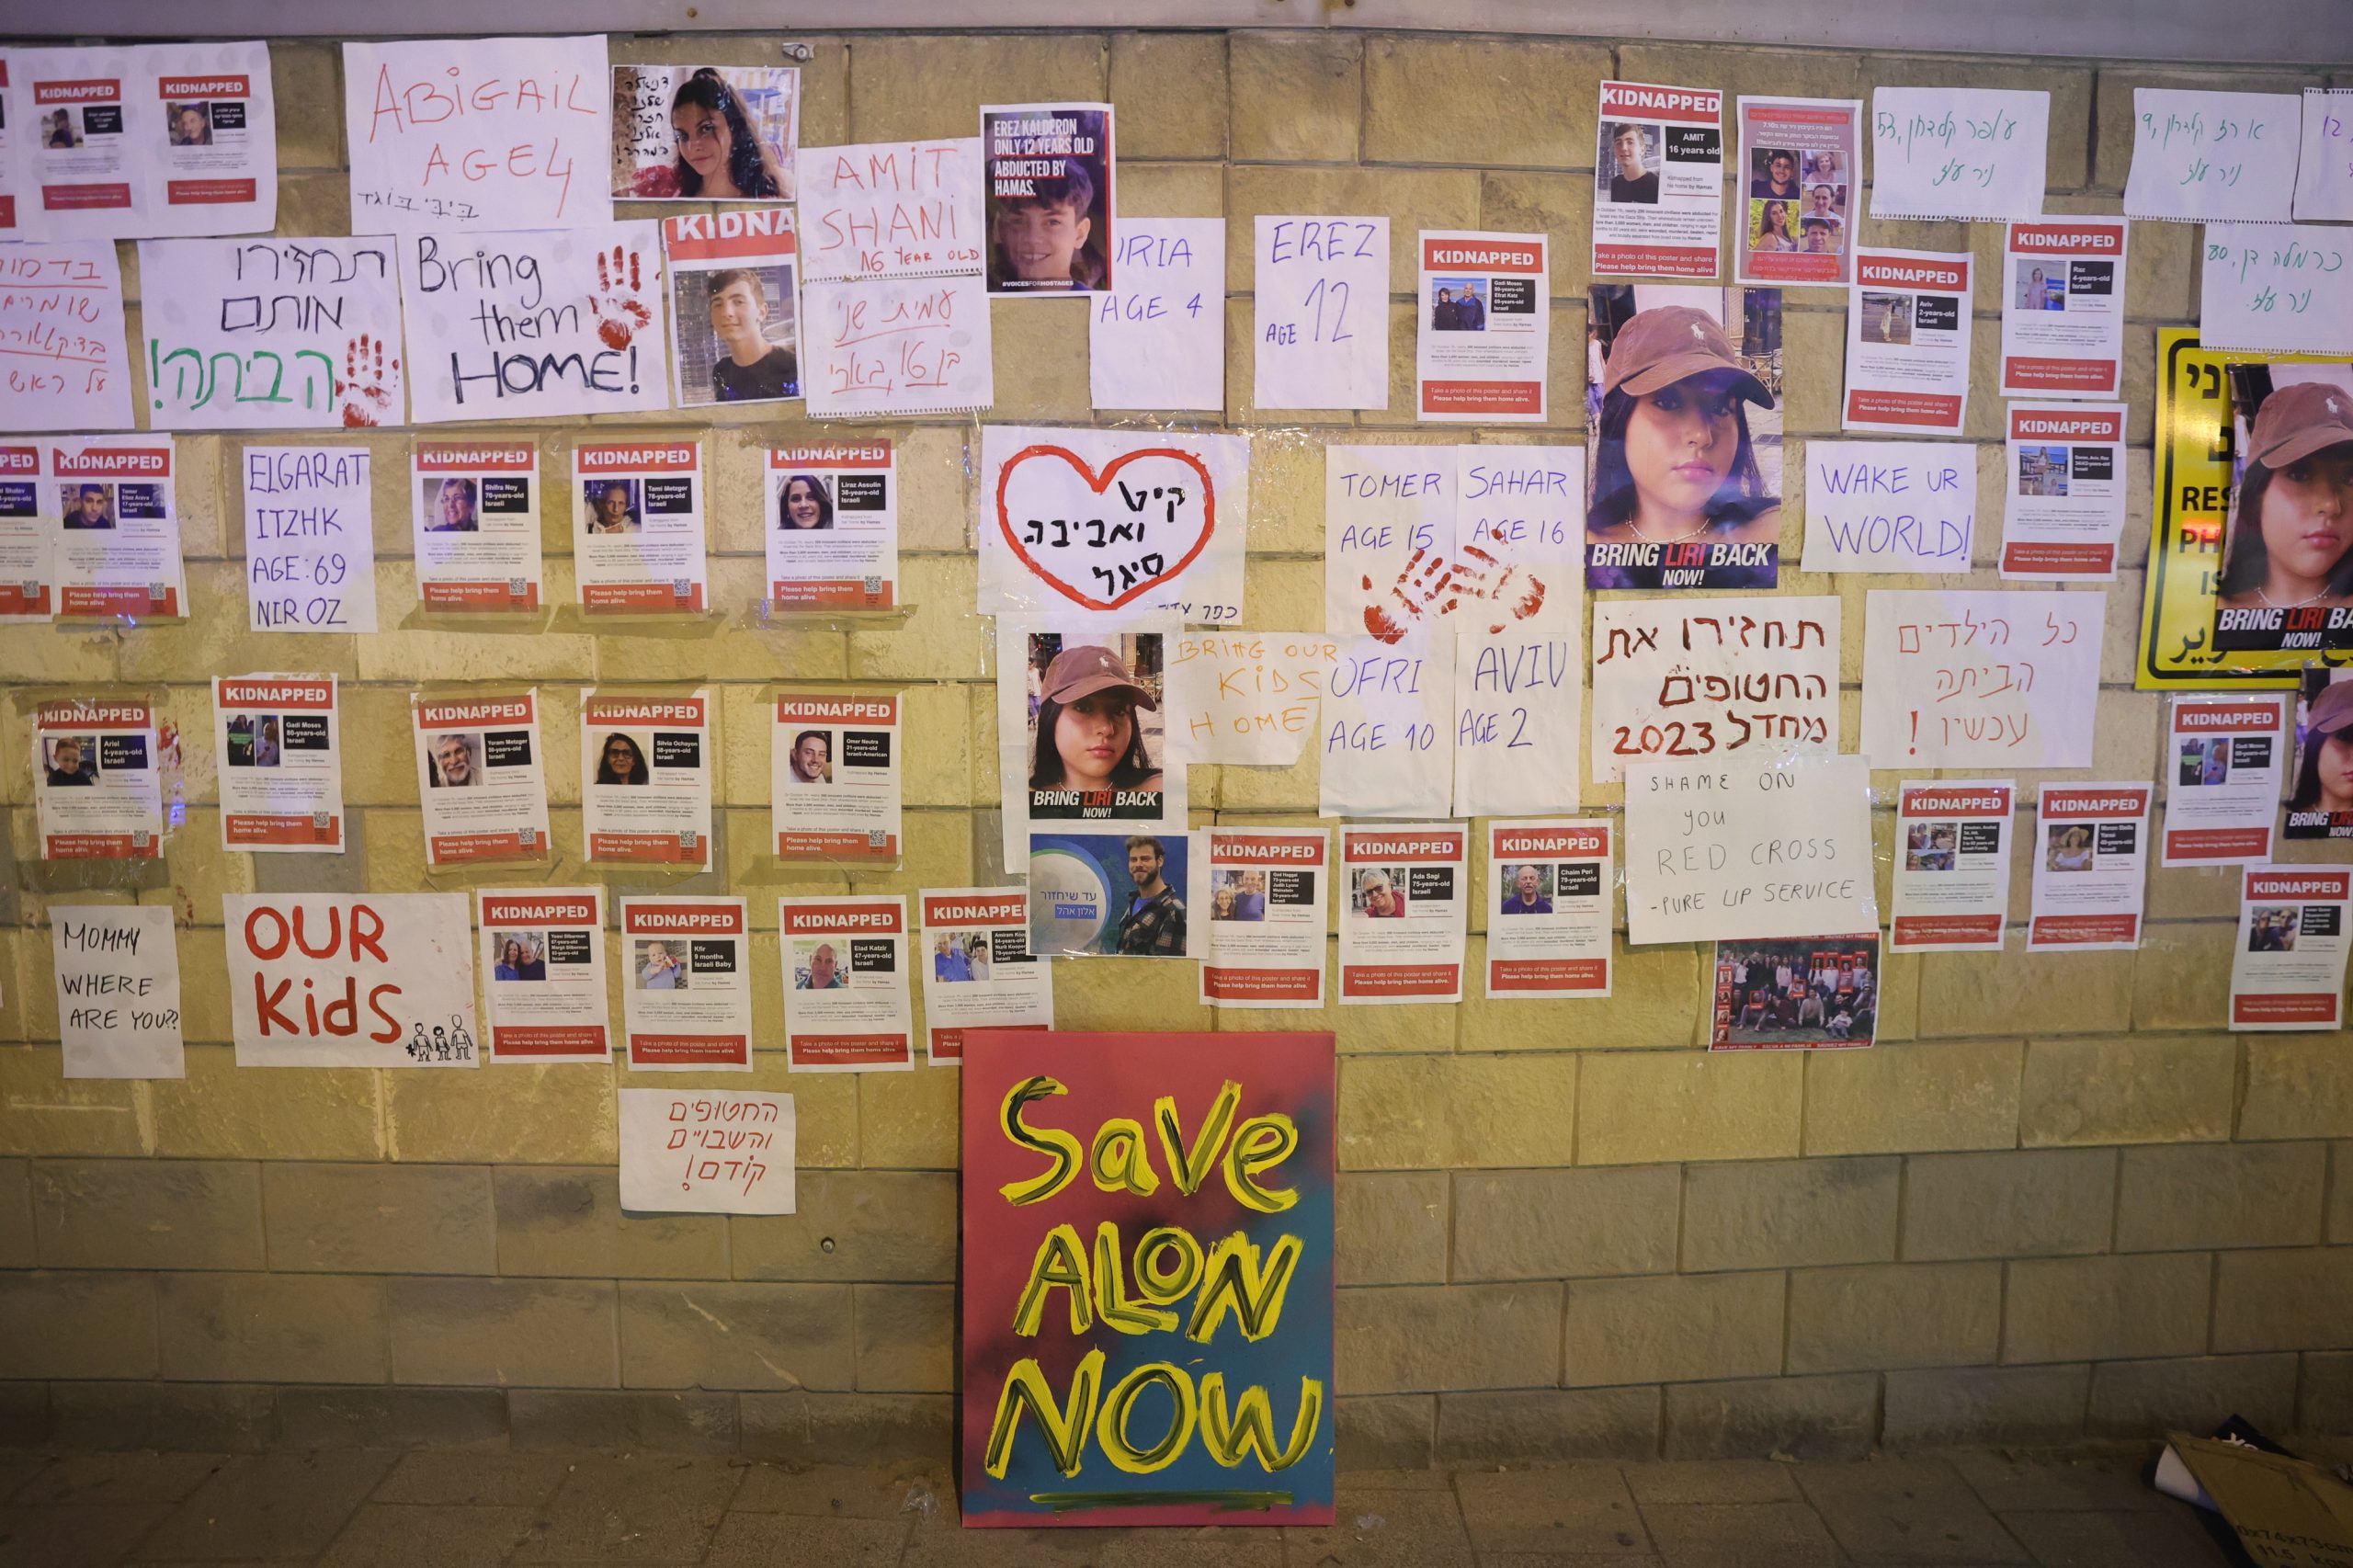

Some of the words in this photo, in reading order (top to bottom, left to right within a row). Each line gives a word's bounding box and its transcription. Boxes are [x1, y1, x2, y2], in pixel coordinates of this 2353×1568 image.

[40, 86, 114, 97] KIDNAPPED
[165, 82, 243, 94] KIDNAPPED
[1603, 89, 1720, 113] KIDNAPPED
[994, 120, 1019, 136] EREZ
[1022, 119, 1076, 135] KALDERON
[1683, 133, 1705, 142] AMIT
[995, 140, 1020, 155] ONLY
[1025, 140, 1035, 154] 12
[1037, 138, 1072, 154] YEARS
[1074, 138, 1094, 153] OLD
[1669, 146, 1678, 154] 16
[1680, 146, 1703, 157] years
[1705, 146, 1720, 154] old
[995, 161, 1050, 176] ABDUCTED
[1052, 160, 1066, 176] BY
[995, 179, 1036, 196] HAMAS.
[1272, 222, 1378, 263] EREZ
[2018, 232, 2115, 248] KIDNAPPED
[949, 248, 979, 261] OLD
[1433, 249, 1535, 266] KIDNAPPED
[418, 236, 542, 310] Bring
[1638, 264, 1656, 272] bring
[1861, 265, 1959, 285] KIDNAPPED
[222, 295, 343, 334] אותם
[1101, 295, 1168, 323] AGE
[1187, 292, 1204, 320] 4
[1266, 324, 1297, 345] AGE
[1304, 278, 1354, 343] 12
[471, 300, 579, 346] them
[450, 346, 640, 404] HOME!
[2018, 419, 2112, 434] KIDNAPPED
[423, 449, 528, 464] KIDNAPPED
[584, 449, 690, 465] KIDNAPPED
[778, 447, 884, 460] KIDNAPPED
[59, 455, 163, 470] KIDNAPPED
[249, 452, 369, 493] ELGARAT
[1821, 462, 1910, 494] WAKE
[1927, 469, 1959, 492] UR
[1339, 472, 1441, 499] TOMER
[1465, 467, 1568, 499] SAHAR
[256, 506, 344, 539] ITZHK
[1341, 525, 1393, 551] AGE
[1407, 524, 1435, 550] 15
[1472, 520, 1527, 542] AGE
[1539, 520, 1564, 544] 16
[1824, 514, 1972, 562] WORLD!
[1591, 544, 1659, 567] BRING
[1665, 544, 1707, 566] LIRI
[1711, 543, 1769, 567] BACK
[1662, 568, 1703, 585] NOW!
[257, 598, 300, 627] NIR
[306, 597, 347, 625] OZ
[2219, 608, 2283, 631] BRING
[2287, 608, 2325, 629] LIRI
[2281, 631, 2321, 648] NOW!
[1287, 643, 1337, 662] OUR
[226, 687, 327, 701] KIDNAPPED
[43, 709, 144, 722] KIDNAPPED
[425, 703, 527, 721] KIDNAPPED
[593, 704, 699, 720] KIDNAPPED
[784, 703, 890, 718] KIDNAPPED
[2182, 712, 2273, 725] KIDNAPPED
[1460, 709, 1498, 746] AGE
[1507, 708, 1533, 748] 2
[1328, 721, 1387, 754] AGE
[1405, 723, 1434, 752] 10
[1614, 722, 1715, 756] 2023
[1651, 774, 1729, 791] SHAME
[1759, 772, 1794, 790] ON
[1034, 791, 1080, 806] BRING
[1083, 791, 1112, 806] LIRI
[1116, 791, 1157, 806] BACK
[1911, 797, 2002, 810] KIDNAPPED
[2050, 799, 2140, 812] KIDNAPPED
[1082, 807, 1112, 818] NOW!
[2290, 812, 2329, 826] BRING
[1213, 844, 1315, 858] KIDNAPPED
[1353, 842, 1454, 855] KIDNAPPED
[1502, 837, 1600, 851] KIDNAPPED
[1657, 844, 1727, 875] RED
[1751, 838, 1836, 865] CROSS
[1764, 880, 1855, 902] SERVICE
[2254, 881, 2341, 893] KIDNAPPED
[1040, 891, 1081, 901] שיחזור
[1084, 892, 1097, 901] עד
[492, 906, 588, 919] KIDNAPPED
[634, 915, 733, 927] KIDNAPPED
[793, 914, 893, 927] KIDNAPPED
[63, 922, 141, 956] MOMMY
[244, 904, 389, 963] OUR
[715, 960, 732, 969] Baby
[63, 973, 153, 997] WHERE
[70, 1009, 118, 1029] ARE
[1013, 1221, 1307, 1344] ALON
[984, 1344, 1323, 1480] NOW
